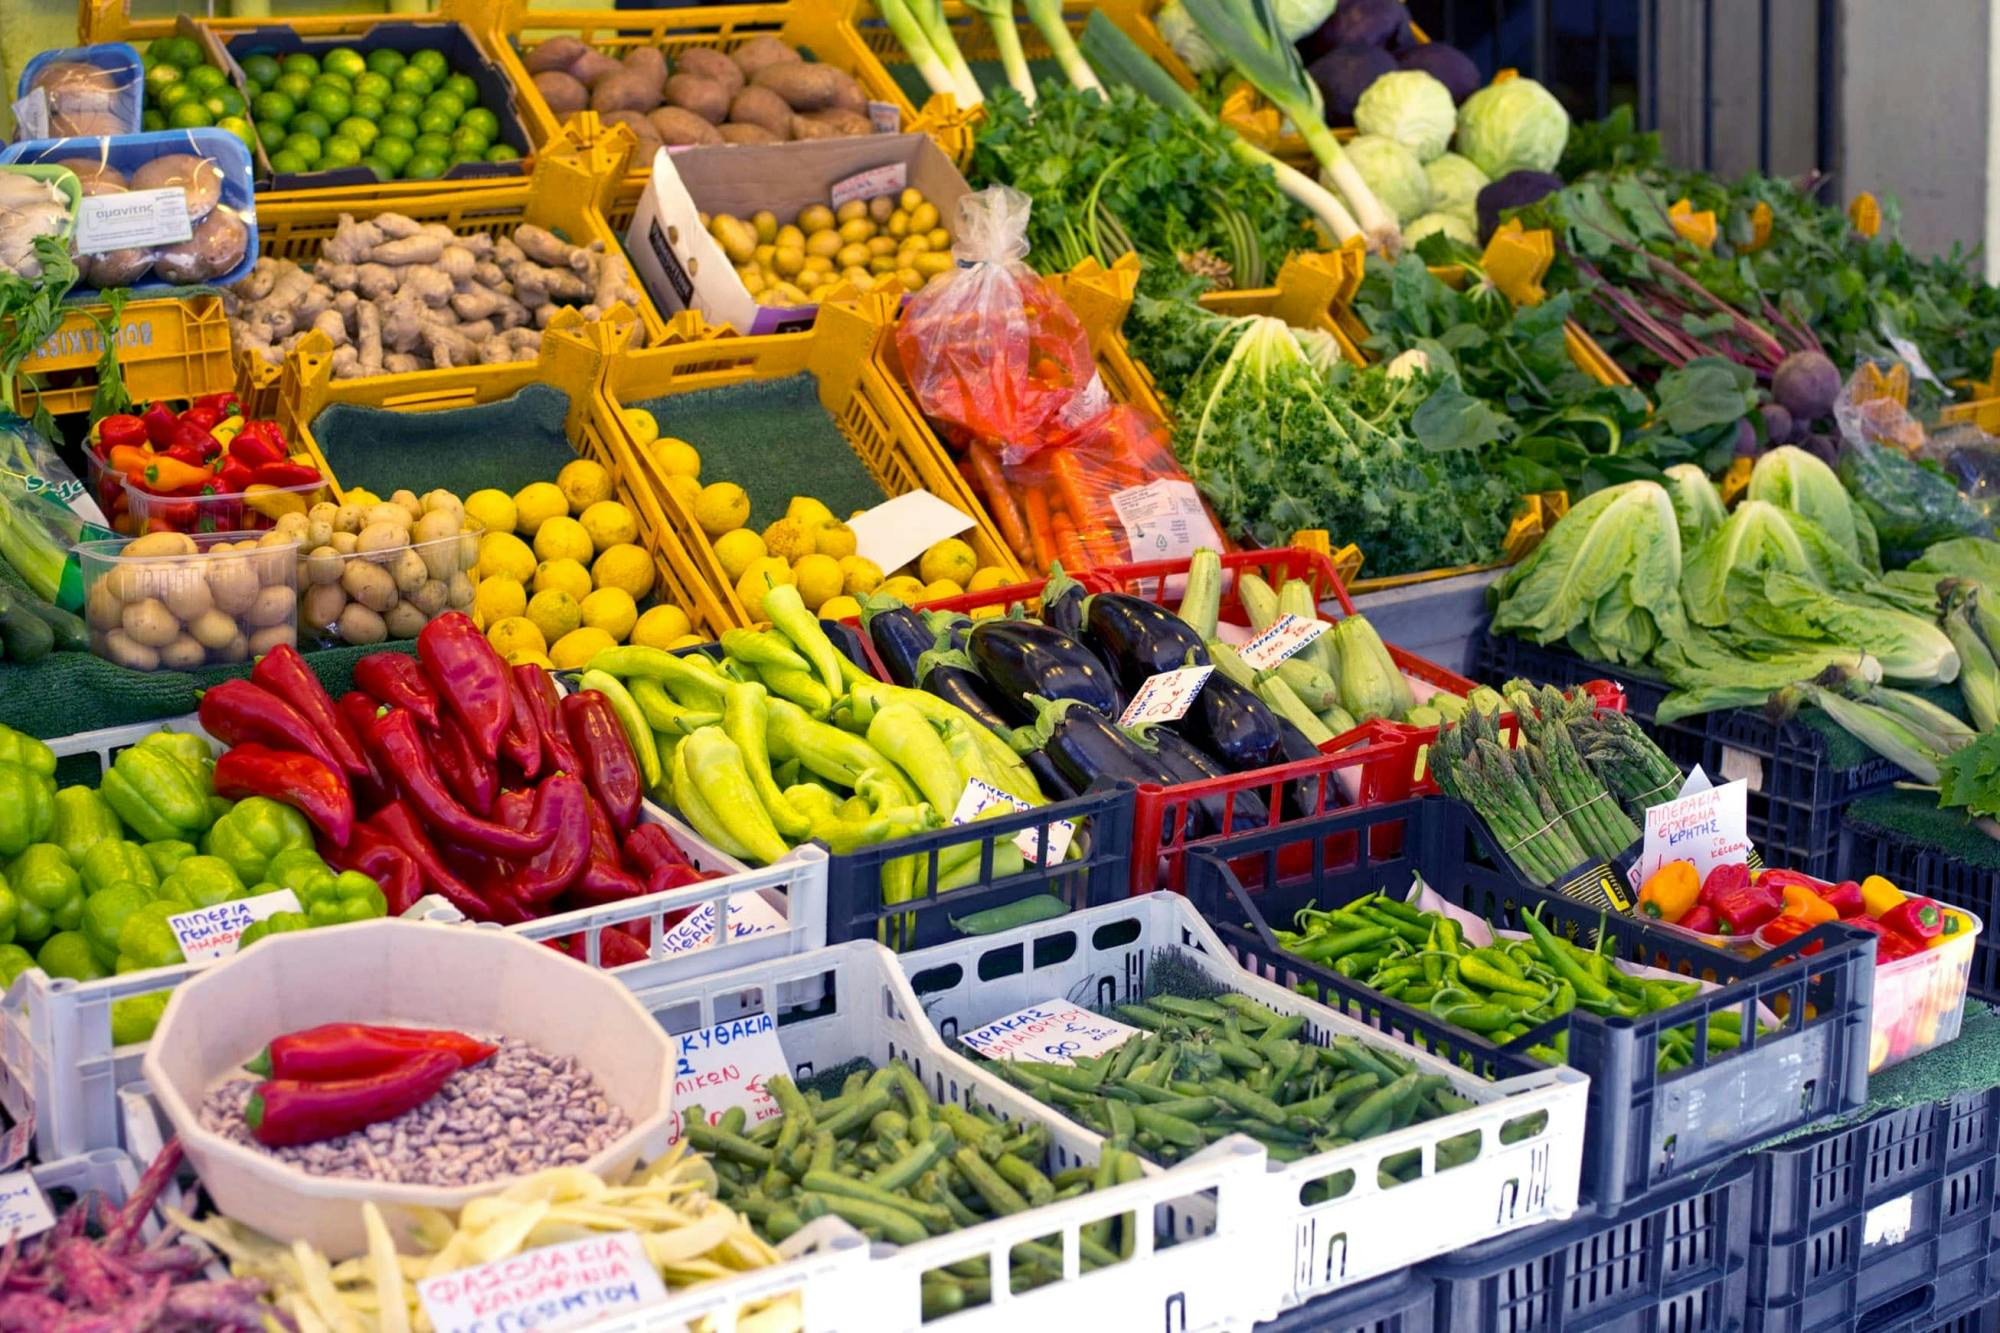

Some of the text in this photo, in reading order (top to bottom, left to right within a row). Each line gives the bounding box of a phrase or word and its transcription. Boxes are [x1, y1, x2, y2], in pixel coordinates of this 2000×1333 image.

[1669, 819, 1721, 847] ΚΡΗΤΗΣ
[171, 902, 250, 929] ΠΙΠΕΡΙΑ
[681, 1014, 774, 1056] ΚΥΘΑΚΙΑ
[964, 1008, 1056, 1049] ΑΡΑΚΑΣ
[675, 1064, 741, 1096] ΛΙΚΩΝ
